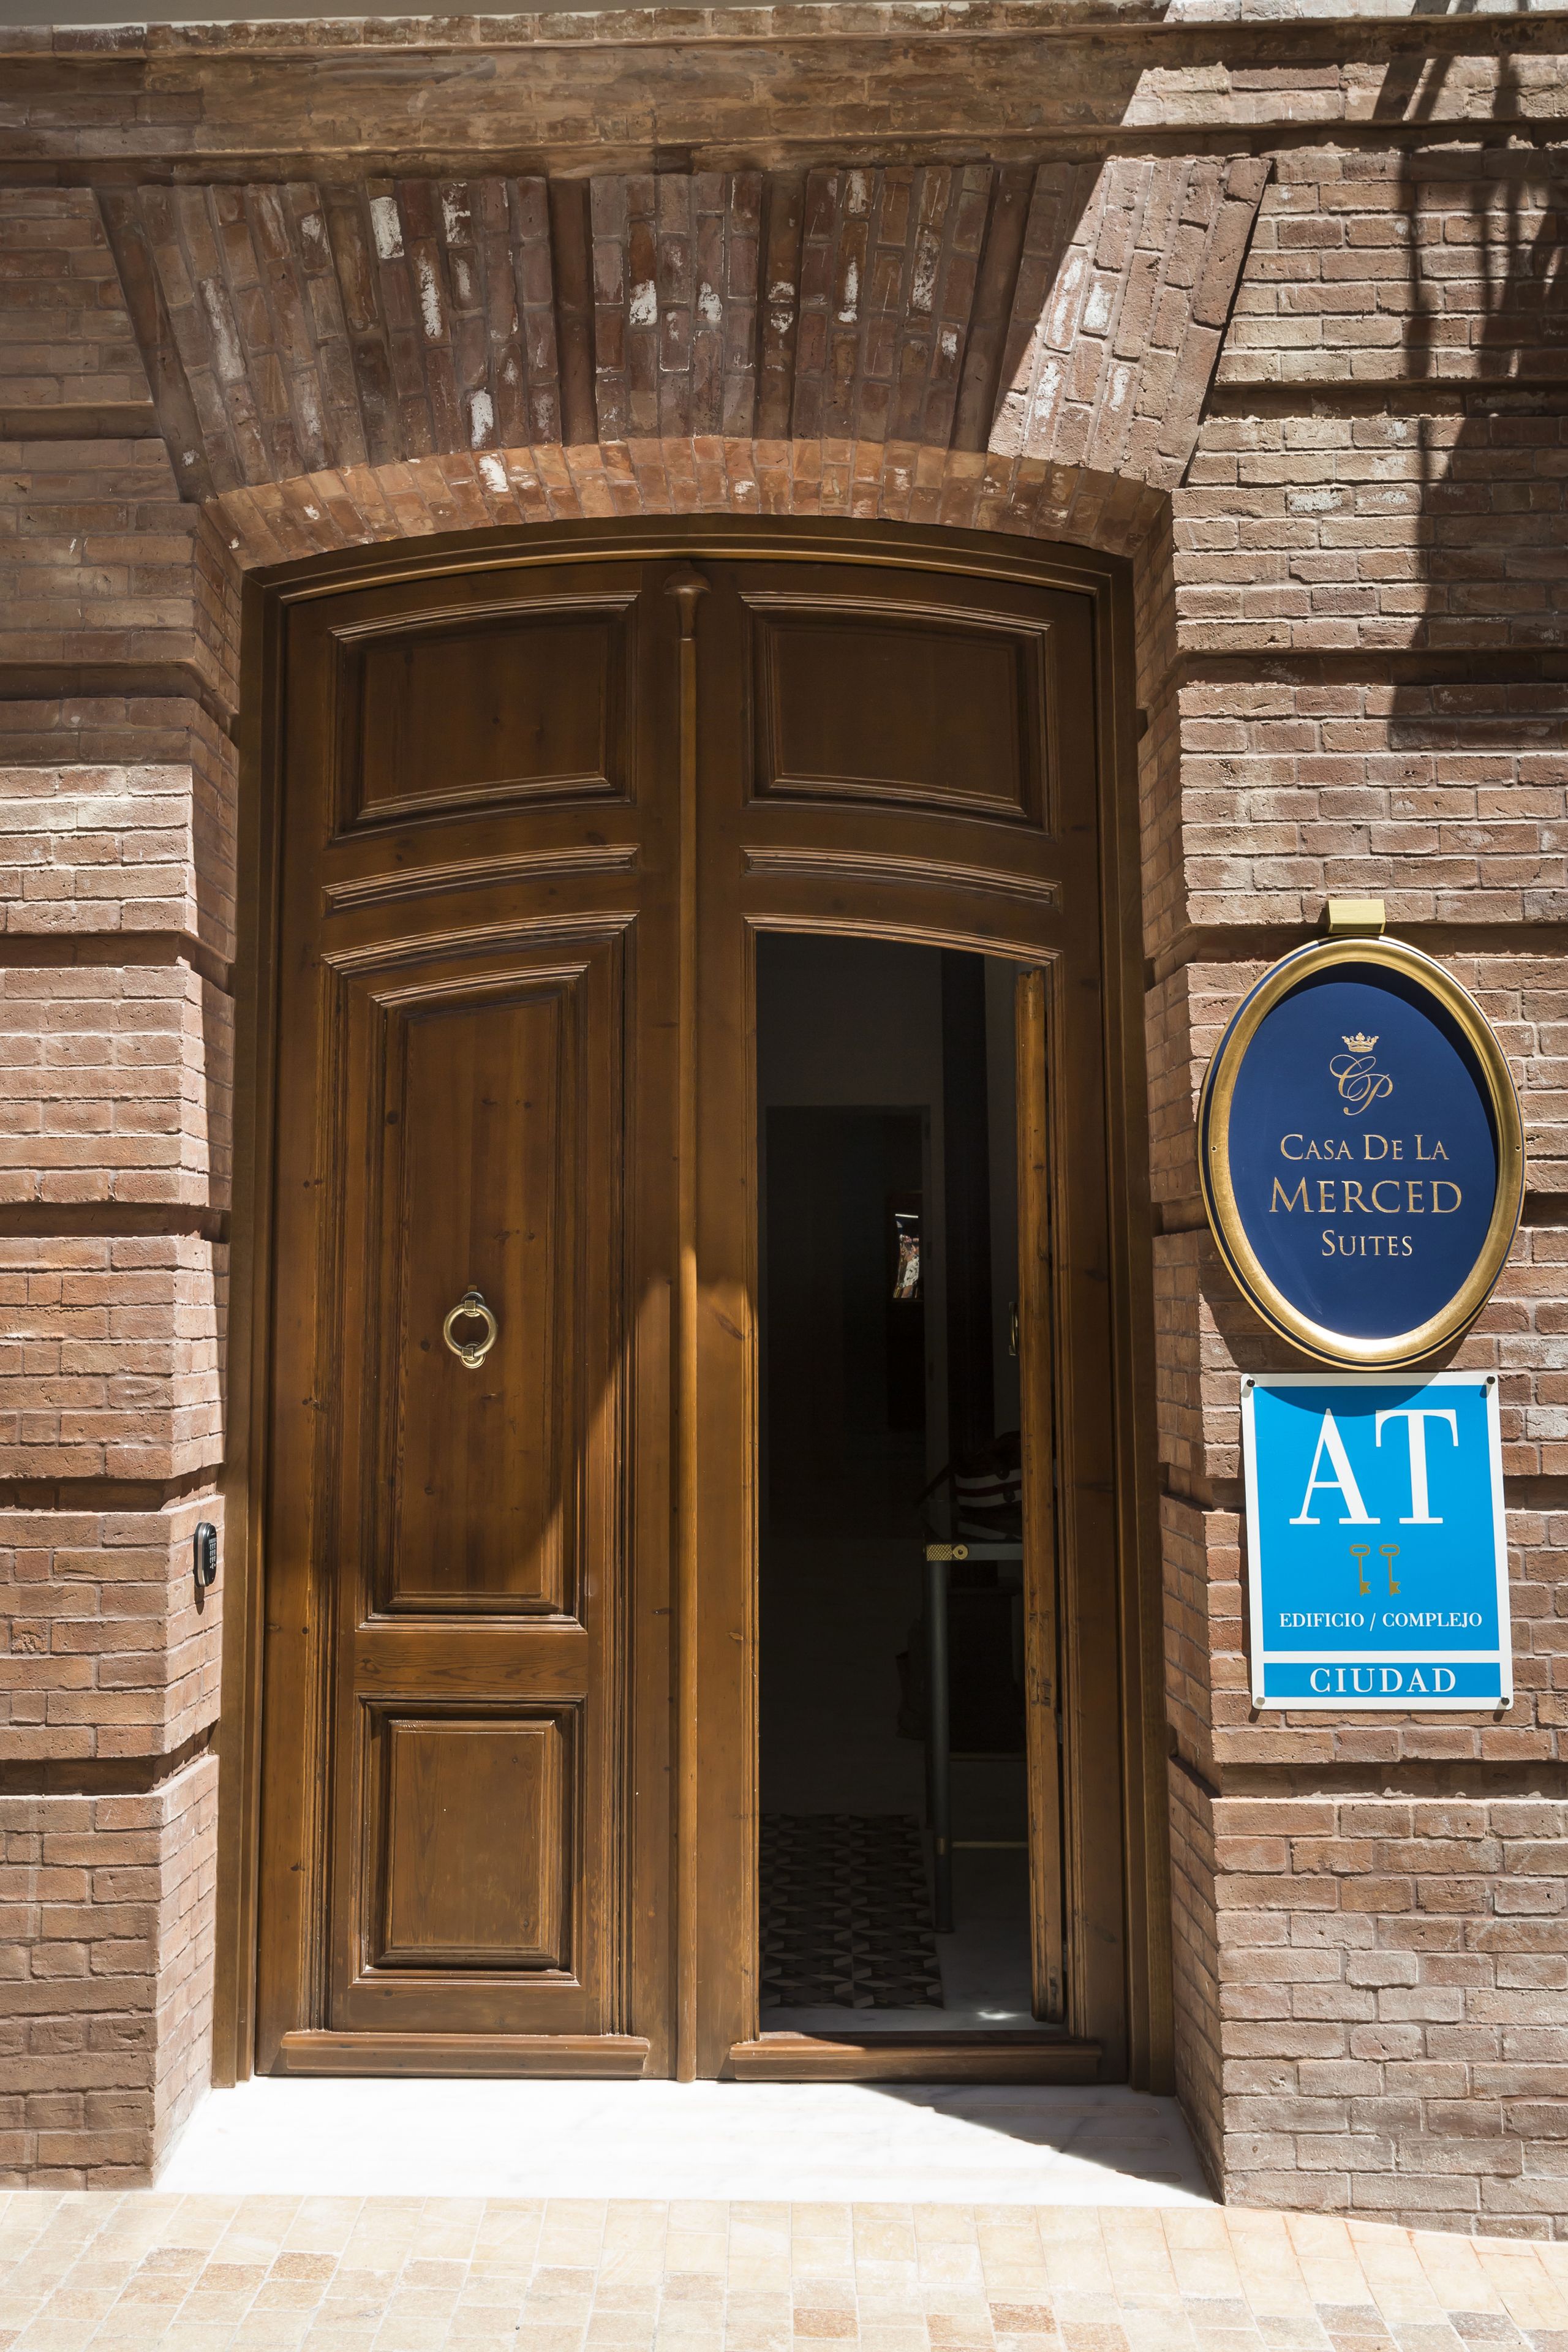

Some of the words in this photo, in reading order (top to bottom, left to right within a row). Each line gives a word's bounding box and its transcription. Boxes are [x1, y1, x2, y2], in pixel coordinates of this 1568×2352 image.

[1280, 1134, 1354, 1160] CASA
[1363, 1134, 1403, 1160] DE
[1415, 1134, 1450, 1160] LA
[1268, 1177, 1462, 1213] MERCED
[1321, 1229, 1412, 1256] SUITES
[1289, 1408, 1459, 1525] AT
[1279, 1613, 1365, 1627] EDIFICIO
[1382, 1612, 1482, 1628] COMPLEJO
[1310, 1668, 1456, 1693] CIUDAD
